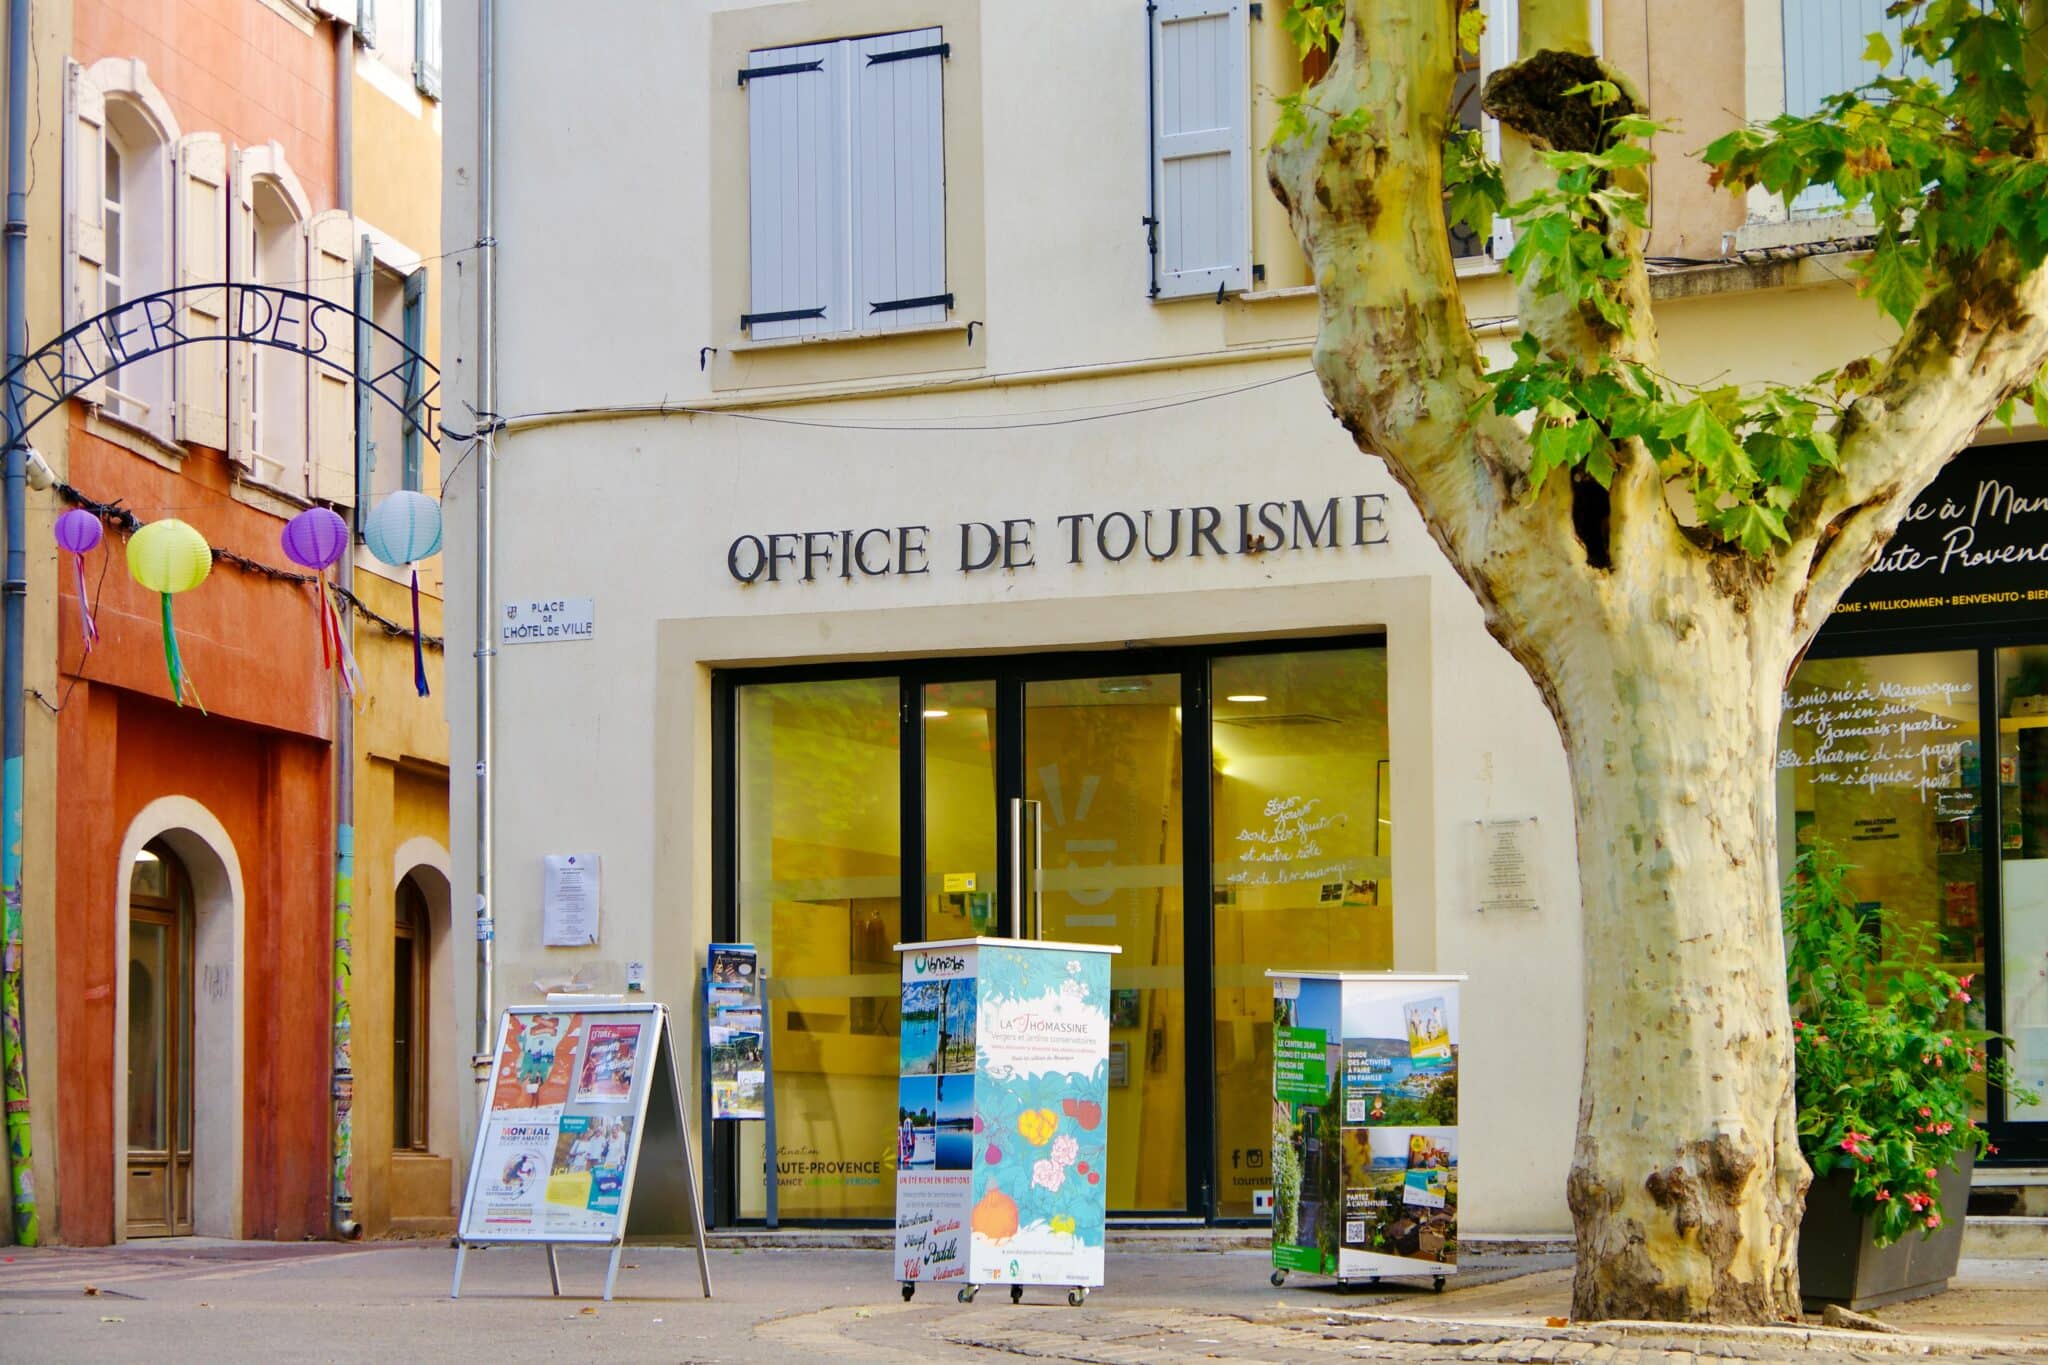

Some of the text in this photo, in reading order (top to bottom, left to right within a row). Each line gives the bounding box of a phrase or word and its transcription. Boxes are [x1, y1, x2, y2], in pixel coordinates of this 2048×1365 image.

[0, 287, 440, 450] ARTIER DES AR
[1940, 497, 1967, 519] à
[1971, 479, 2048, 527] Man
[727, 493, 1389, 583] OFFICE DE TOURISME
[531, 601, 565, 613] PLACE
[1869, 596, 1943, 611] WILLKOMMEN
[1951, 591, 2019, 605] BENVENUTO
[542, 615, 552, 623] DE
[504, 622, 592, 639] L'HÔTEL DE VILLE
[1792, 709, 1814, 725] et
[1000, 1020, 1014, 1030] LA
[502, 1127, 550, 1136] MONDIAL
